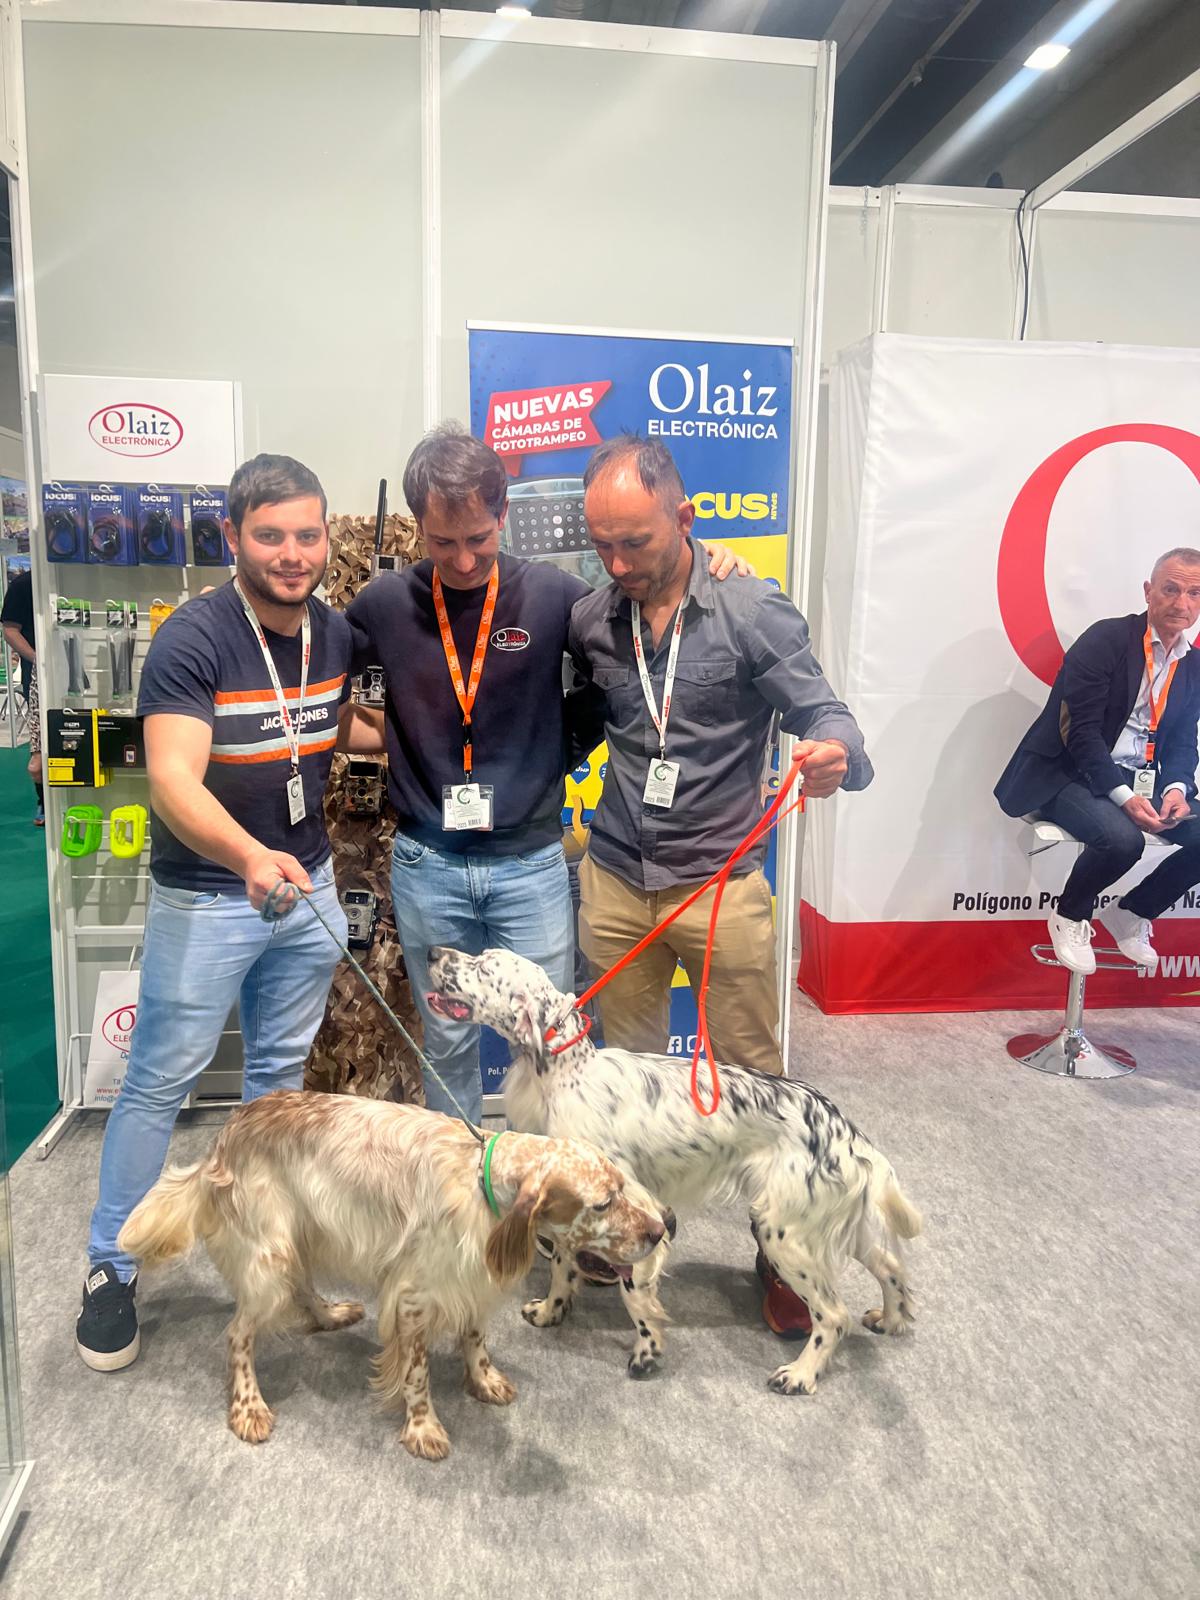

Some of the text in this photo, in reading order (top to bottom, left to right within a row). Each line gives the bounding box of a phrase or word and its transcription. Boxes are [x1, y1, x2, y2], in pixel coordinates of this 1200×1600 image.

[648, 363, 778, 417] Olaiz
[494, 387, 594, 424] NUEVAS
[102, 410, 170, 436] Olaiz
[492, 417, 582, 439] CÁMARAS DE
[648, 418, 778, 440] ELECTRÓNICA
[102, 436, 171, 446] ELECTRÓNICA
[493, 431, 587, 452] FOTOTRAMPEO
[686, 491, 770, 520] CUS
[770, 492, 778, 520] SPAIN
[952, 892, 1032, 914] Polígono
[488, 1067, 501, 1076] Pol.
